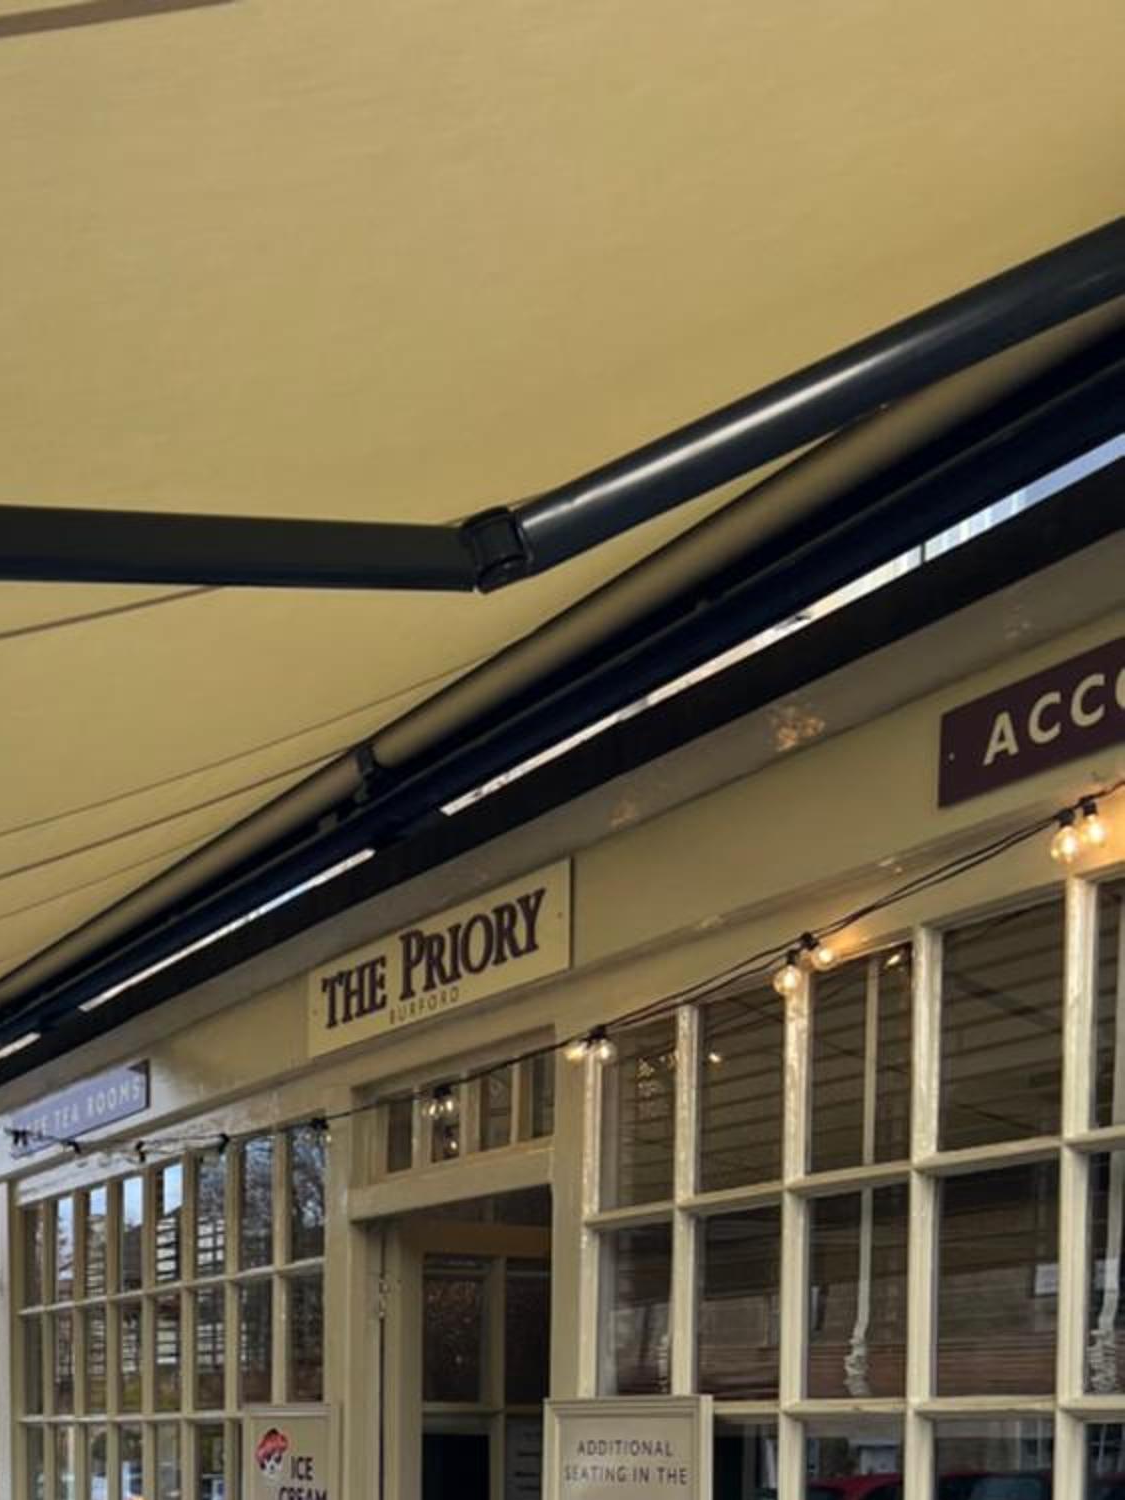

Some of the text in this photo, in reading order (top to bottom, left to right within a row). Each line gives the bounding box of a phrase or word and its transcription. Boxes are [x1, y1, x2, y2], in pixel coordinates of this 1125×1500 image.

[983, 667, 1125, 766] ACC
[321, 887, 546, 1029] THE PRIORY
[389, 986, 460, 1025] BURFORD
[86, 1076, 141, 1117] ROOMS
[576, 1439, 674, 1457] ADDITIONAL
[290, 1455, 314, 1481] ICE
[564, 1464, 688, 1485] SEATING IN THE
